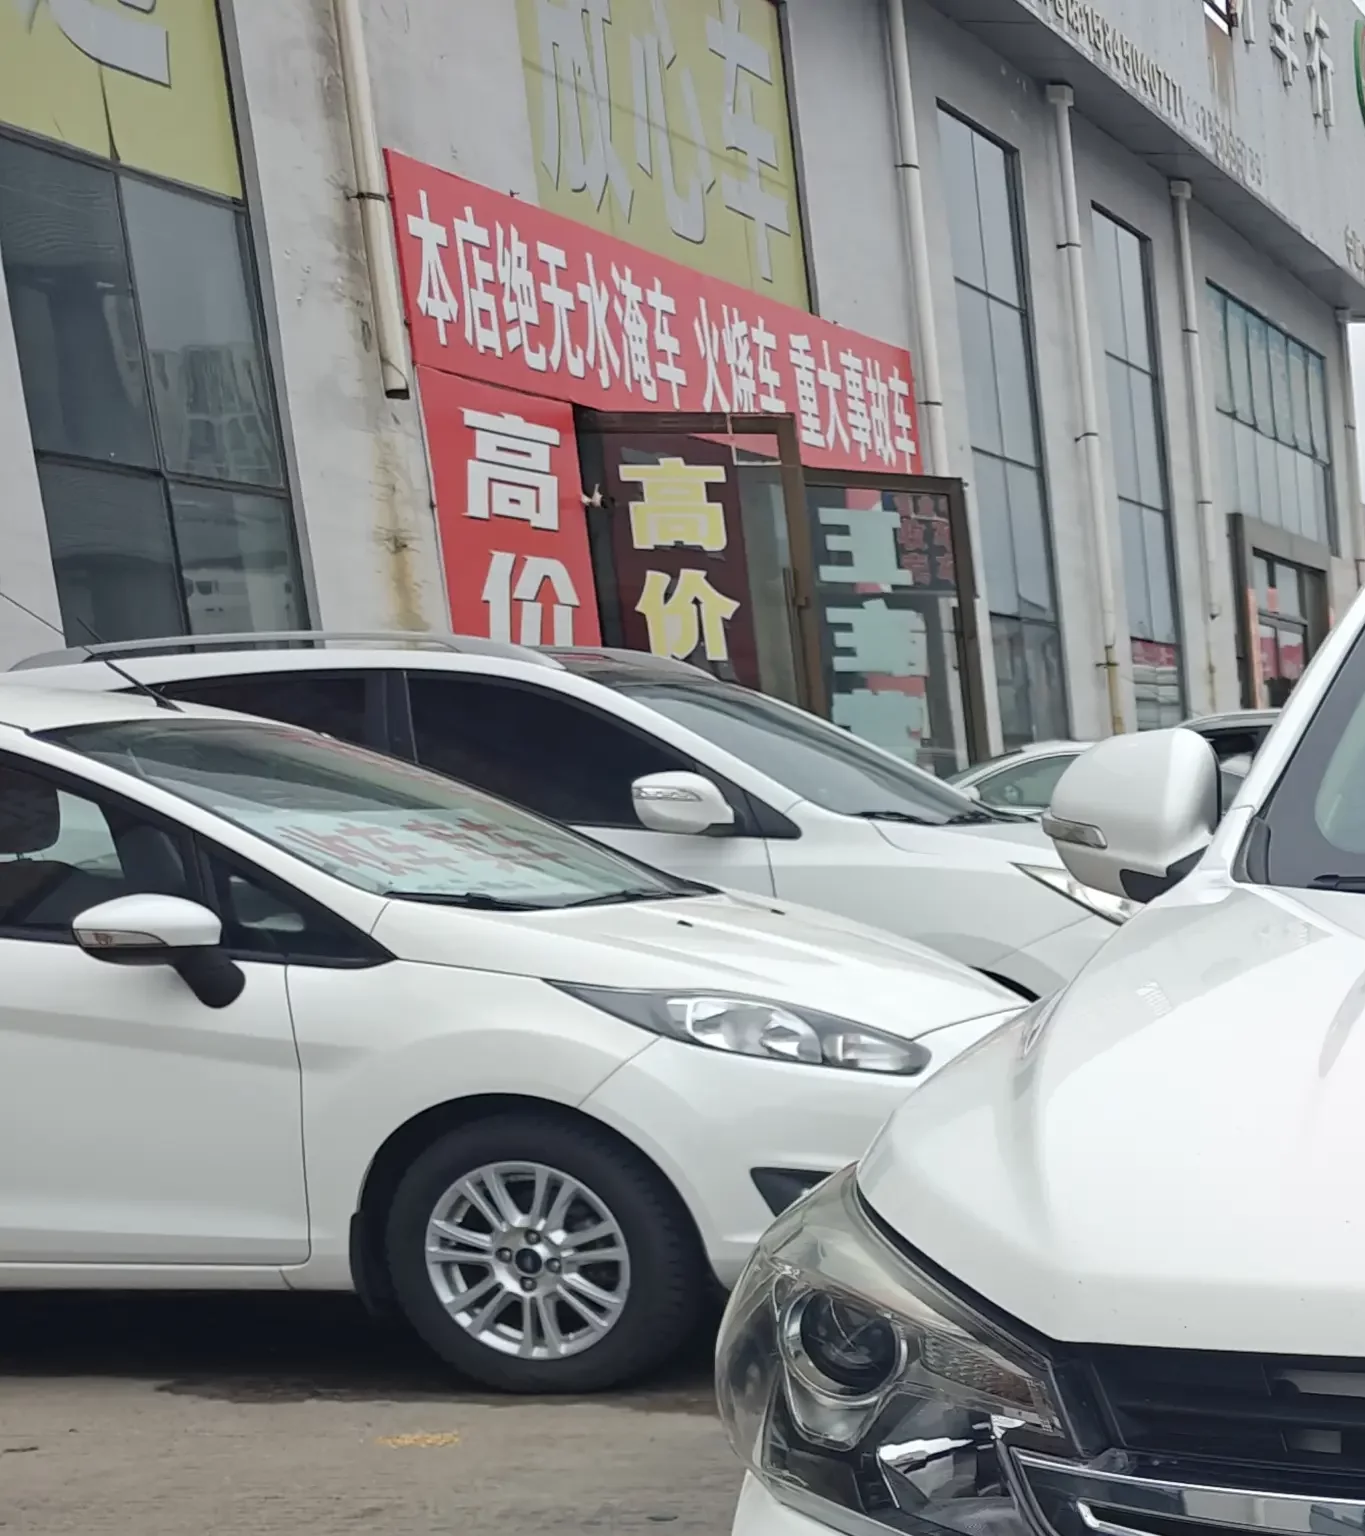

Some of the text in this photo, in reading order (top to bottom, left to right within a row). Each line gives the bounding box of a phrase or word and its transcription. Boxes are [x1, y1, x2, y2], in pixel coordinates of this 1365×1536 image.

[406, 189, 917, 475] 本店绝无水淹车 火烧车 重大事故车
[458, 406, 580, 648] 高价
[618, 456, 741, 662] 高价
